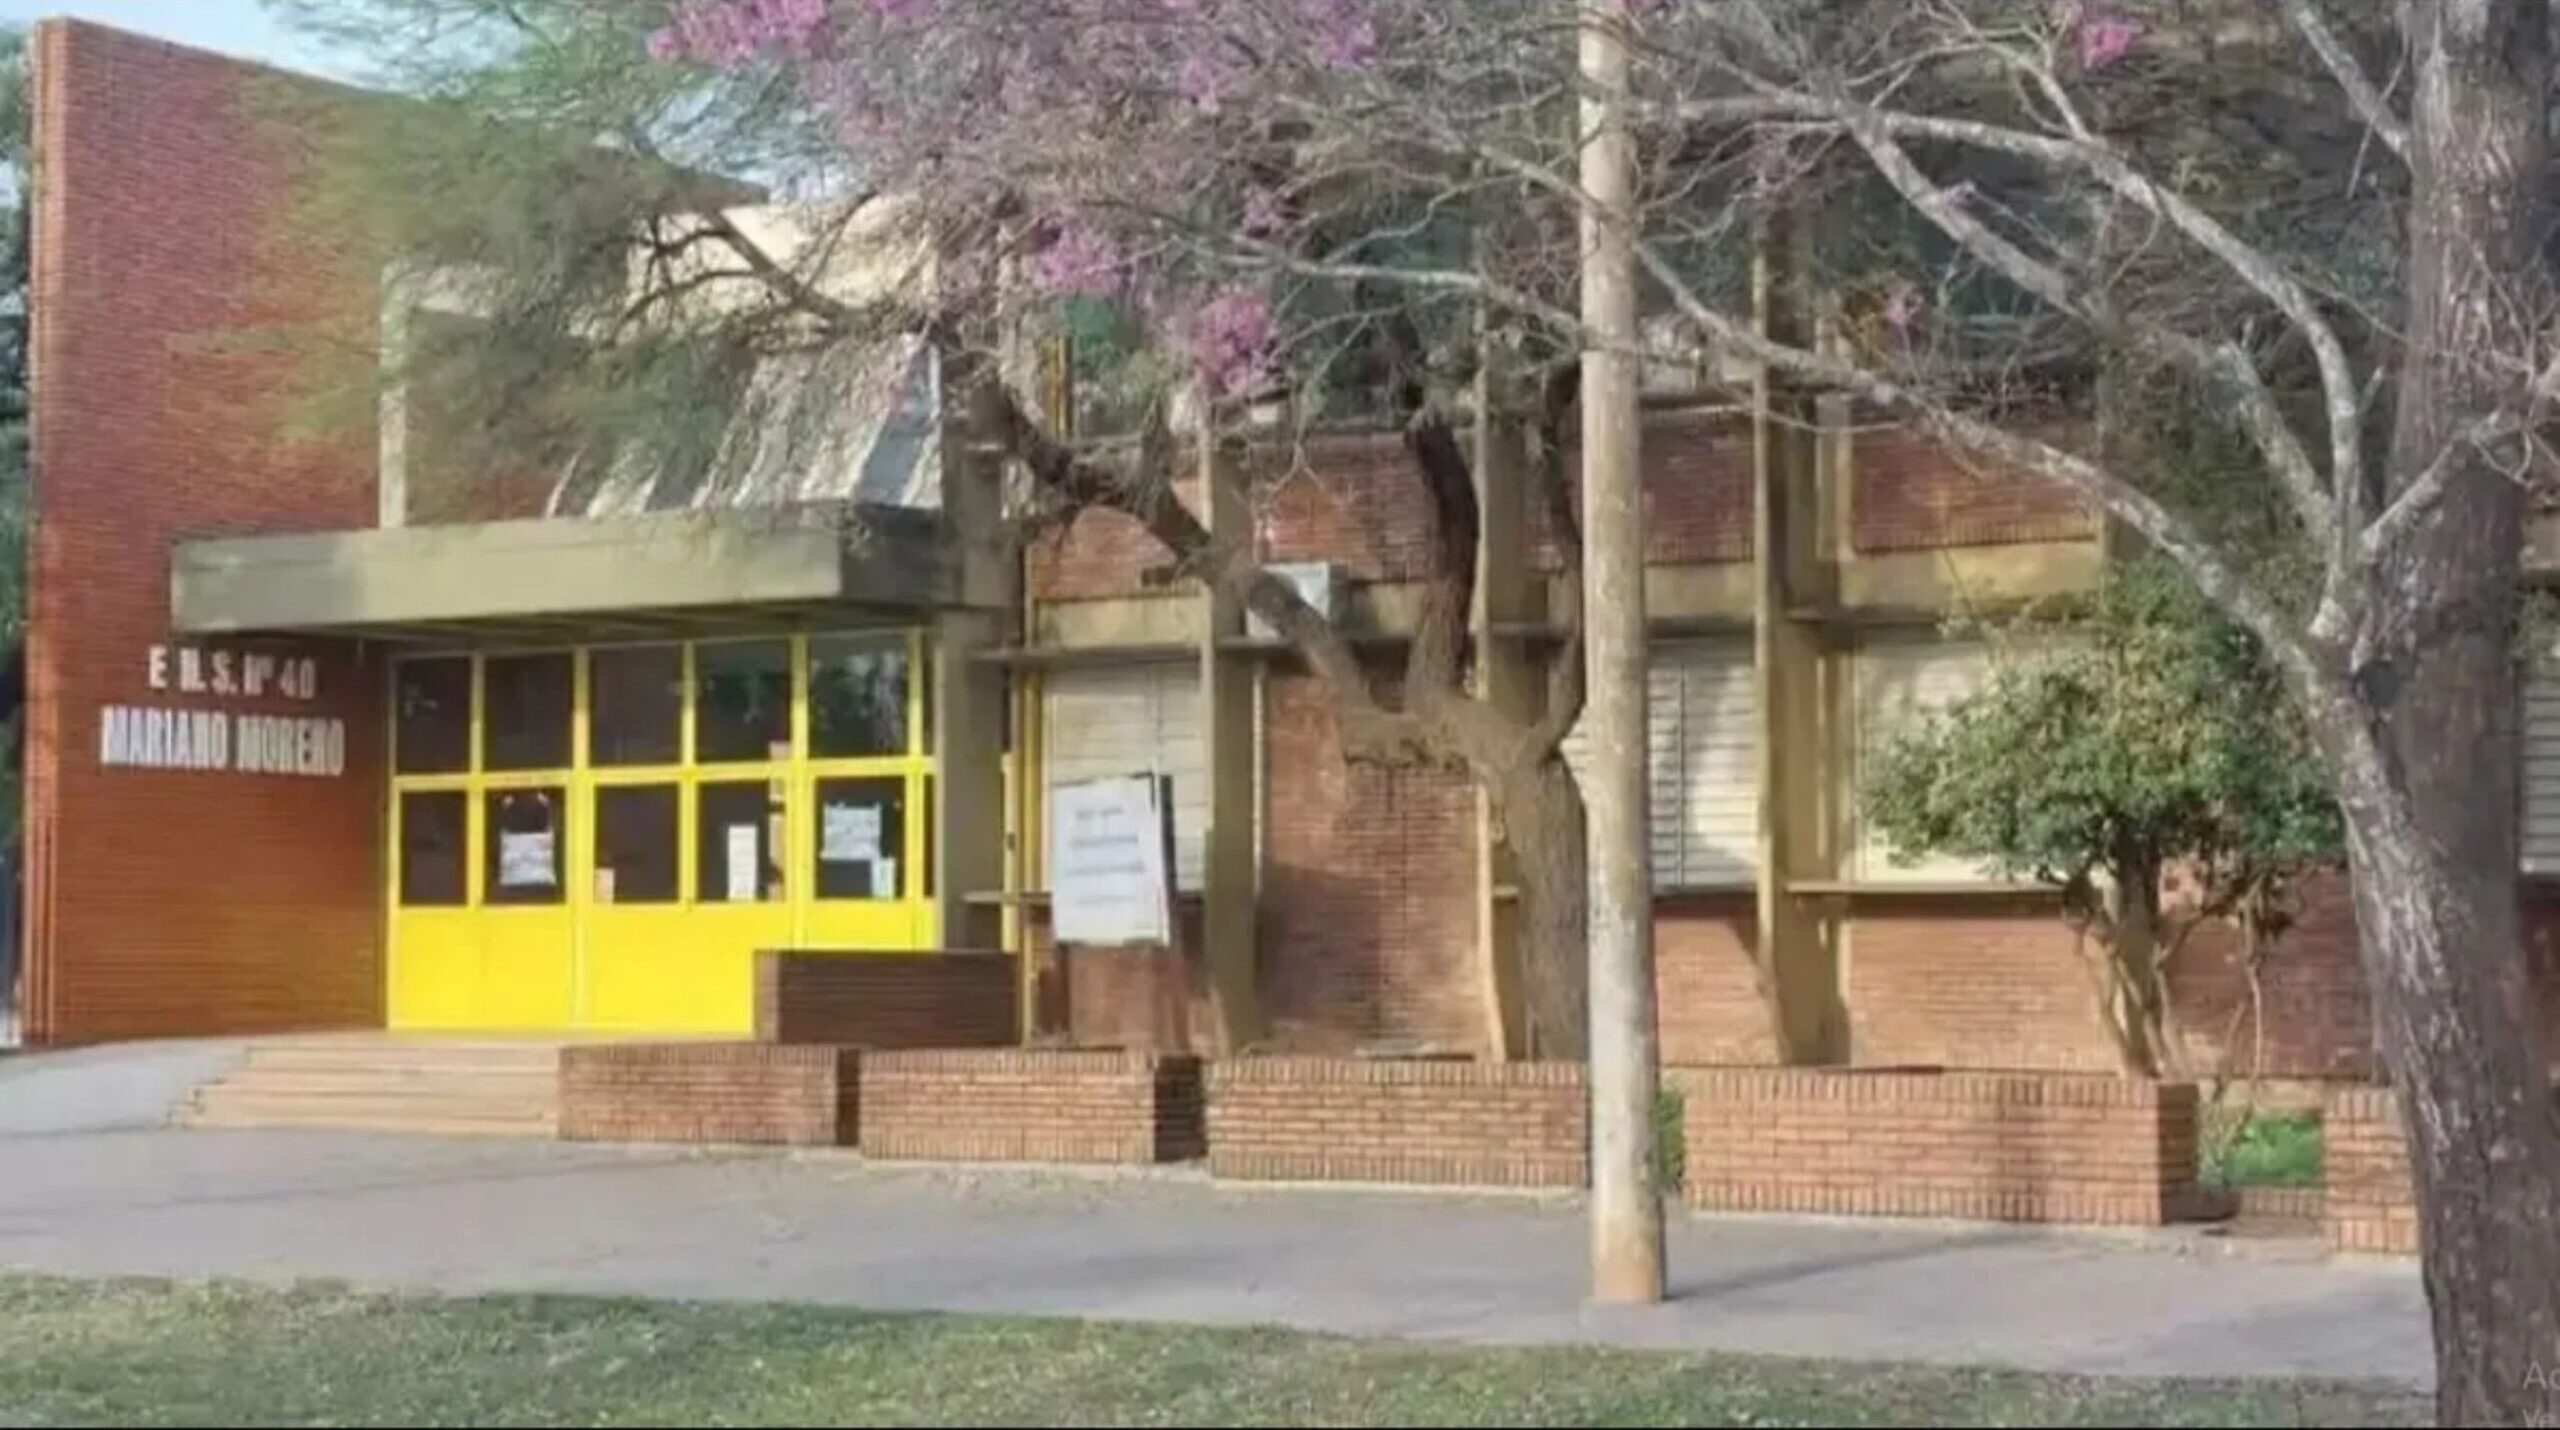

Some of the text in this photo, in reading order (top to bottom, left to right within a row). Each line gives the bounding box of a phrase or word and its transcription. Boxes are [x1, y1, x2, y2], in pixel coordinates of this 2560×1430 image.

[279, 657, 316, 699] 40
[101, 705, 345, 777] MARIANO MORENO
